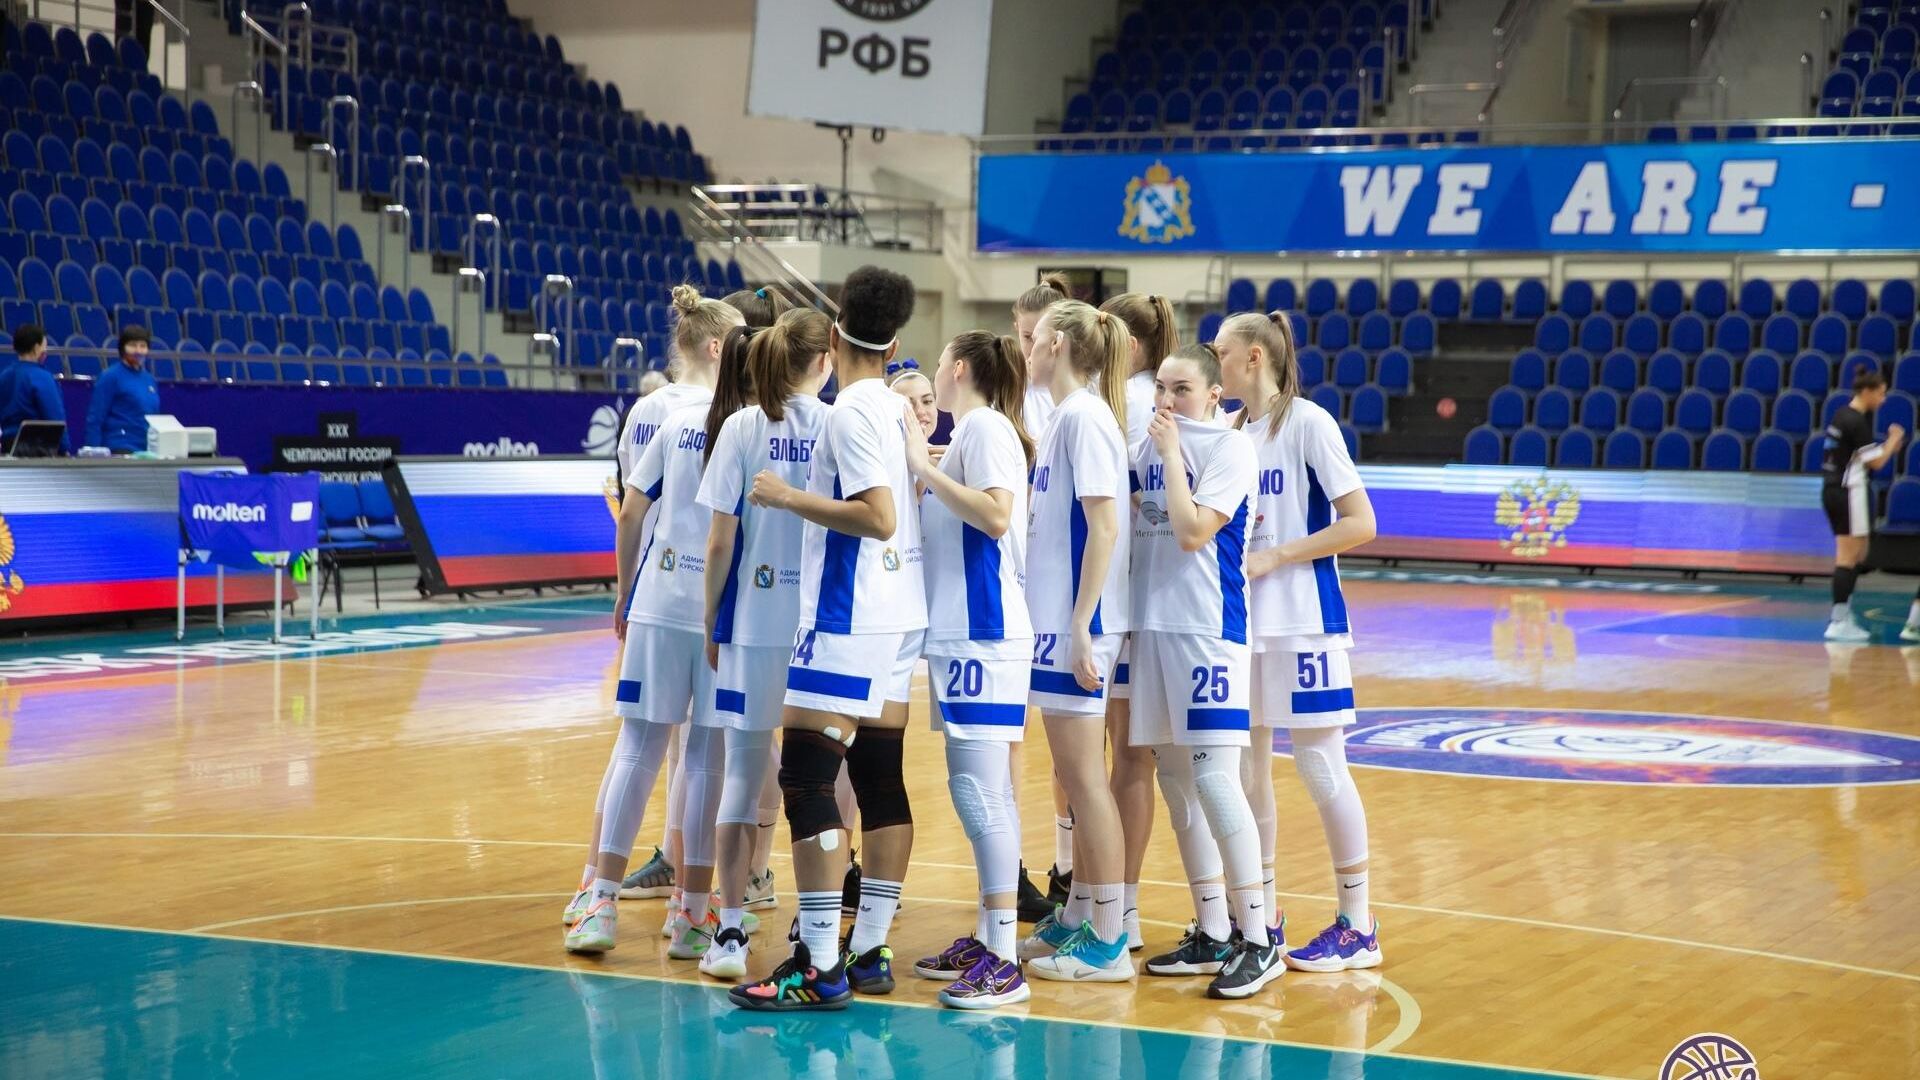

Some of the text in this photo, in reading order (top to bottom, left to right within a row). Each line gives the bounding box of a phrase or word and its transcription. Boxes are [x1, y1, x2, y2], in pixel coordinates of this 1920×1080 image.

[819, 27, 931, 78] РФБ
[1339, 163, 1492, 236] WE
[1550, 160, 1778, 235] ARE
[282, 447, 392, 462] ЧЕМПИОНАТ РОССИИ
[463, 436, 539, 456] molten
[192, 502, 266, 522] molten
[947, 659, 983, 697] 20
[1191, 665, 1229, 704] 25
[1298, 651, 1329, 689] 51
